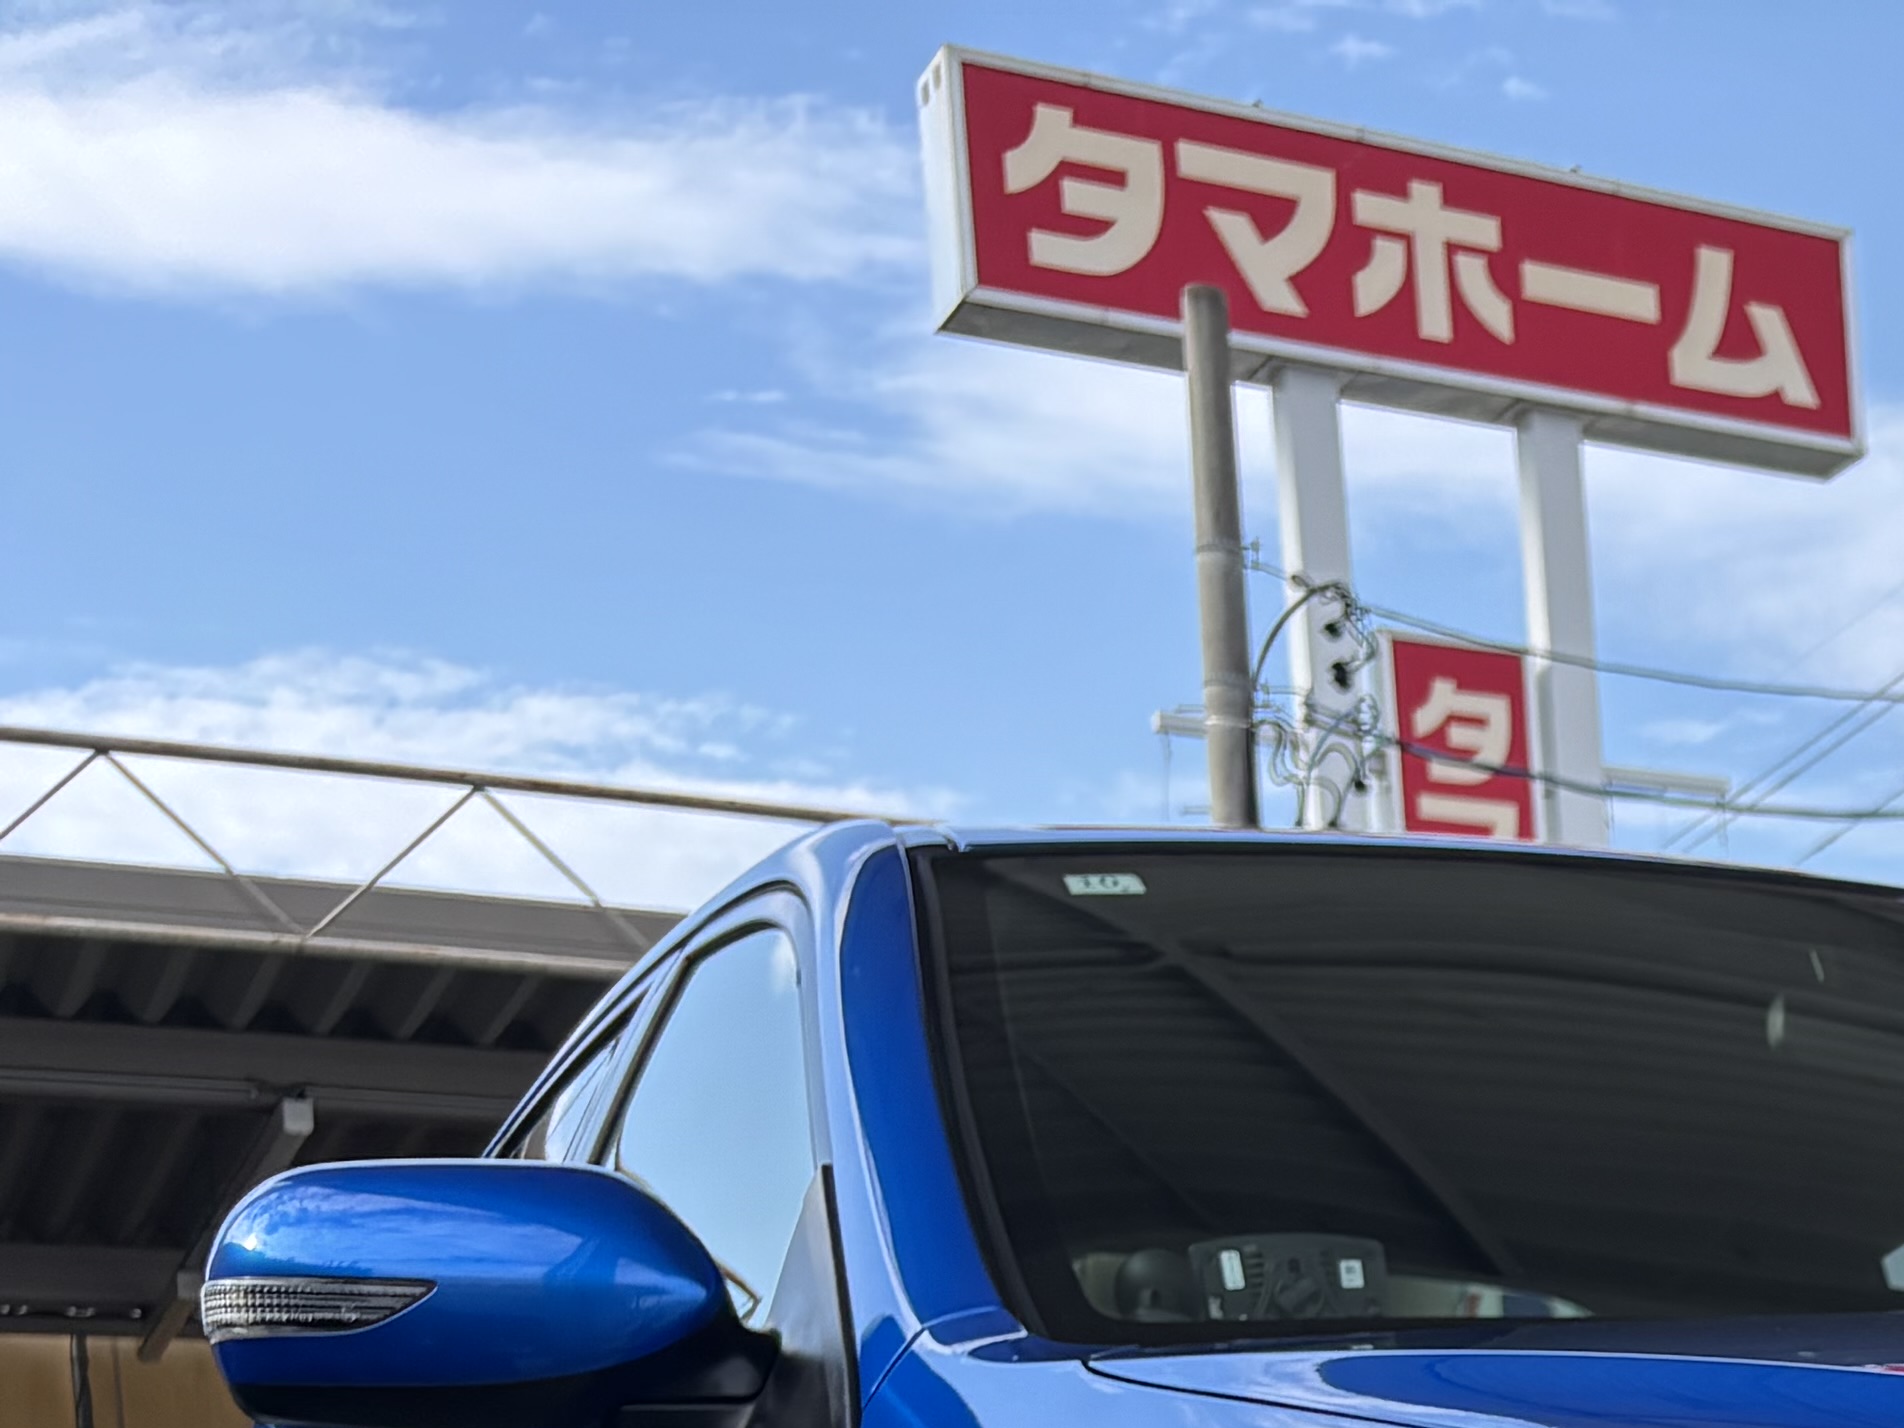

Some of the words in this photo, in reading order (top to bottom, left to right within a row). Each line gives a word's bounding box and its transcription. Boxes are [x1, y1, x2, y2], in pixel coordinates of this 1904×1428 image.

[1001, 103, 1821, 410] タマホーム
